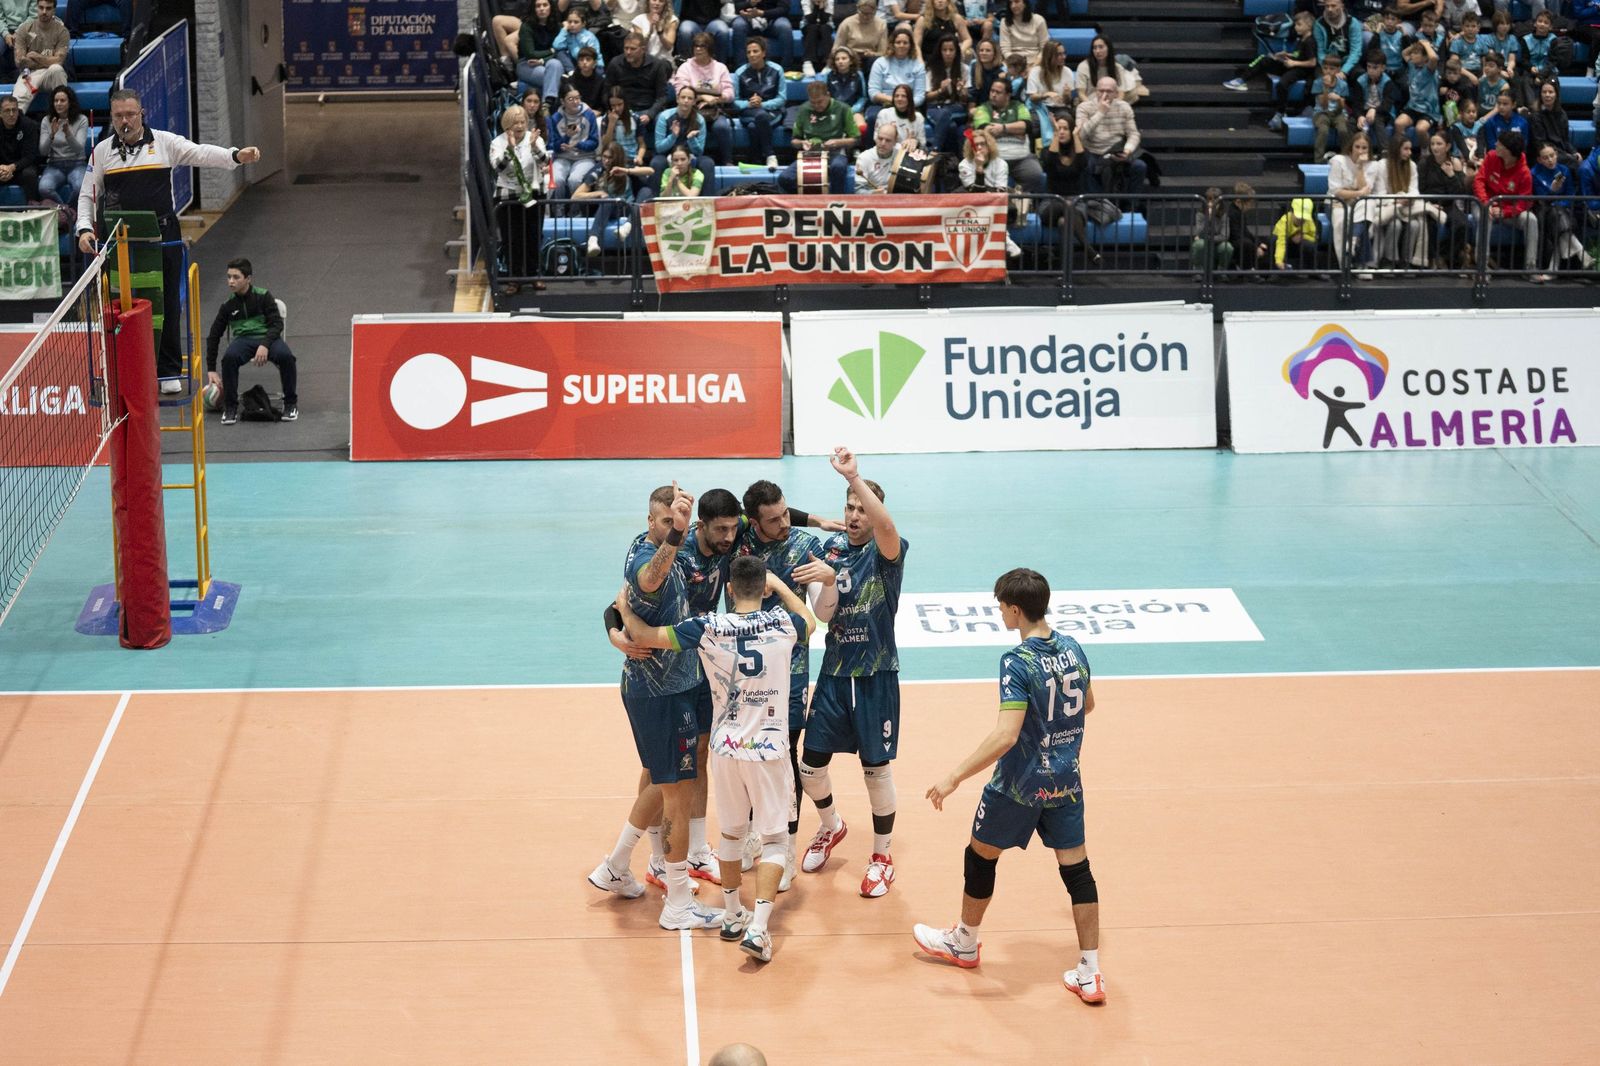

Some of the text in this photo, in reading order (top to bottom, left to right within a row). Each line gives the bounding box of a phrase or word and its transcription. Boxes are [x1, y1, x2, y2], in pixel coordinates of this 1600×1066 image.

[371, 13, 436, 25] DIPUTACIÓN
[371, 24, 433, 35] DE ALMERÍA
[765, 203, 885, 237] PEÑA
[720, 243, 933, 274] LA UNION
[944, 332, 1188, 376] Fundación
[563, 373, 746, 405] SUPERLIGA
[1403, 367, 1569, 396] COSTA DE
[945, 378, 1120, 430] Unicaja
[1370, 398, 1577, 448] ALMERÍA
[709, 568, 720, 601] 7
[920, 616, 1136, 635] Unaja
[736, 635, 764, 677] 5
[1041, 648, 1079, 673] GARCÍA
[742, 687, 779, 697] Fundación
[743, 695, 769, 705] Unicaja
[1046, 671, 1084, 722] 15
[882, 719, 893, 738] 9
[1052, 726, 1084, 740] Fundación
[1052, 735, 1075, 746] Unicaja
